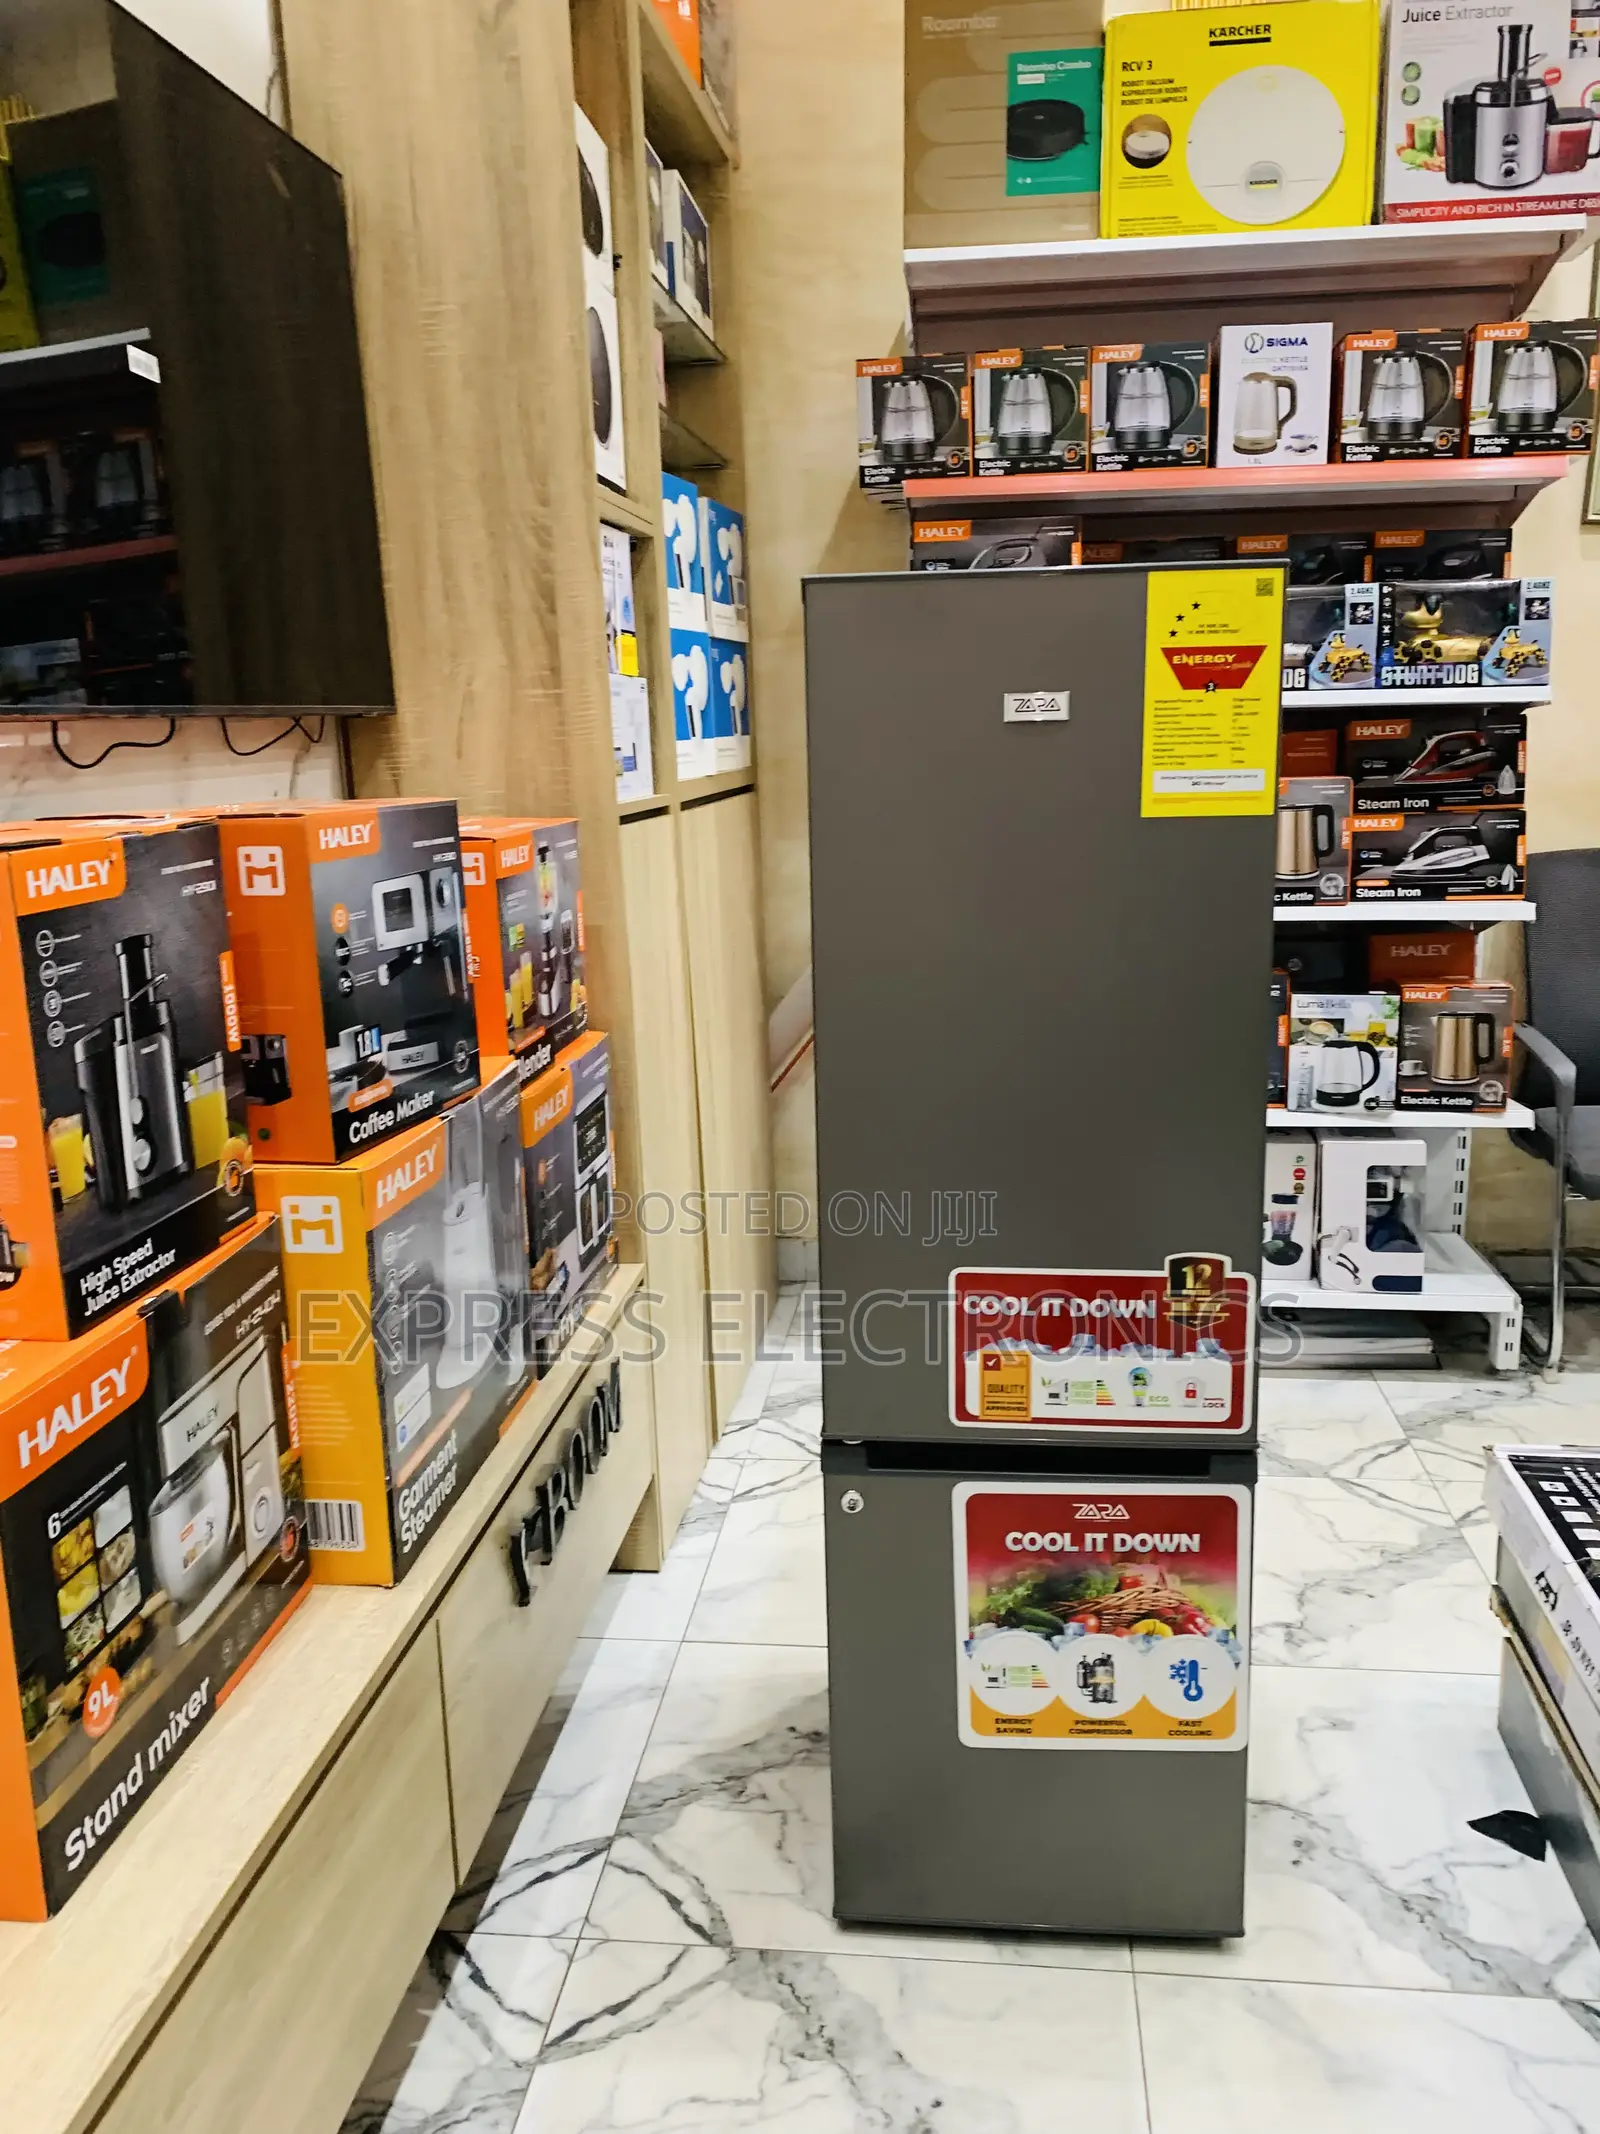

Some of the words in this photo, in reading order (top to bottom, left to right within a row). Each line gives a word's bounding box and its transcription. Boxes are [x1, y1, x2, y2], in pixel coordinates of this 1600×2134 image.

[1402, 9, 1442, 23] Juice
[1445, 5, 1514, 20] Extractor
[1121, 61, 1144, 72] RCV
[1146, 60, 1153, 71] 3
[1397, 206, 1450, 219] SIMPLICITY
[1451, 204, 1476, 216] AND
[1477, 202, 1503, 214] RICH
[1504, 202, 1515, 213] IN
[1515, 199, 1578, 212] STREAMLINE
[1483, 327, 1525, 340] HALEY
[1267, 337, 1308, 347] SIGMA
[1352, 338, 1393, 349] HALEY
[981, 354, 1017, 367] HALEY
[1098, 348, 1137, 361] HALEY
[862, 362, 898, 374] HALEY
[1474, 435, 1509, 447] Electric
[1345, 444, 1380, 455] Electric
[1474, 444, 1502, 455] Kettle
[1096, 453, 1129, 465] Electric
[1345, 452, 1373, 463] Kettle
[978, 458, 1012, 470] Electric
[1096, 462, 1123, 472] Kettle
[864, 466, 896, 477] Electric
[979, 467, 1005, 477] Kettle
[864, 474, 890, 484] Kettle
[919, 526, 965, 538] HALEY
[1241, 539, 1283, 550] HALEY
[1379, 535, 1422, 546] HALEY
[1172, 653, 1237, 667] ENERGY
[1207, 682, 1215, 690] 3
[1355, 724, 1406, 736] HALEY
[1357, 799, 1401, 810] Steam
[1403, 797, 1430, 809] Iron
[1354, 817, 1399, 829] HALEY
[318, 822, 372, 850] HALEY
[501, 844, 531, 869] HALEY
[26, 858, 110, 899] HALEY
[1282, 890, 1315, 902] Kettle
[1355, 888, 1396, 898] Steam
[1397, 887, 1422, 898] Iron
[1391, 944, 1452, 958] HALEY
[1405, 990, 1445, 1001] HALEY
[401, 1051, 425, 1065] HALEY
[1400, 1095, 1441, 1106] Electric
[1441, 1095, 1474, 1107] Kettle
[533, 1085, 569, 1132] HALEY
[349, 1111, 395, 1144] Coffee
[396, 1088, 436, 1122] Maker
[377, 1143, 439, 1208] HALEY
[79, 1260, 111, 1297] High
[112, 1238, 154, 1279] Speed
[83, 1280, 119, 1317] Juice
[119, 1247, 177, 1298] Extractor
[1181, 1263, 1212, 1289] 12
[963, 1295, 1036, 1317] COOL
[1041, 1297, 1066, 1317] IT
[1069, 1298, 1157, 1320] DOWN
[987, 1382, 1026, 1395] QUALITY
[1149, 1395, 1170, 1403] ECO
[1202, 1401, 1227, 1409] LOCK
[17, 1354, 133, 1469] HALEY
[985, 1404, 1028, 1413] APPROVED
[186, 1402, 221, 1442] HALEY
[398, 1429, 459, 1520] Garment
[401, 1463, 458, 1554] Steamer
[47, 1512, 62, 1539] 6
[1005, 1532, 1079, 1553] COOL
[1084, 1532, 1108, 1553] IT
[1113, 1533, 1201, 1553] DOWN
[88, 1680, 115, 1720] 9L
[995, 1718, 1034, 1726] ENERGY
[1074, 1719, 1128, 1728] POWERFUL
[1177, 1720, 1204, 1728] FAST
[995, 1727, 1033, 1735] SAVING
[1068, 1728, 1134, 1736] COMPRESSOR
[1168, 1729, 1213, 1737] COOLING
[64, 1752, 145, 1873] Stand
[148, 1676, 211, 1773] mixer
